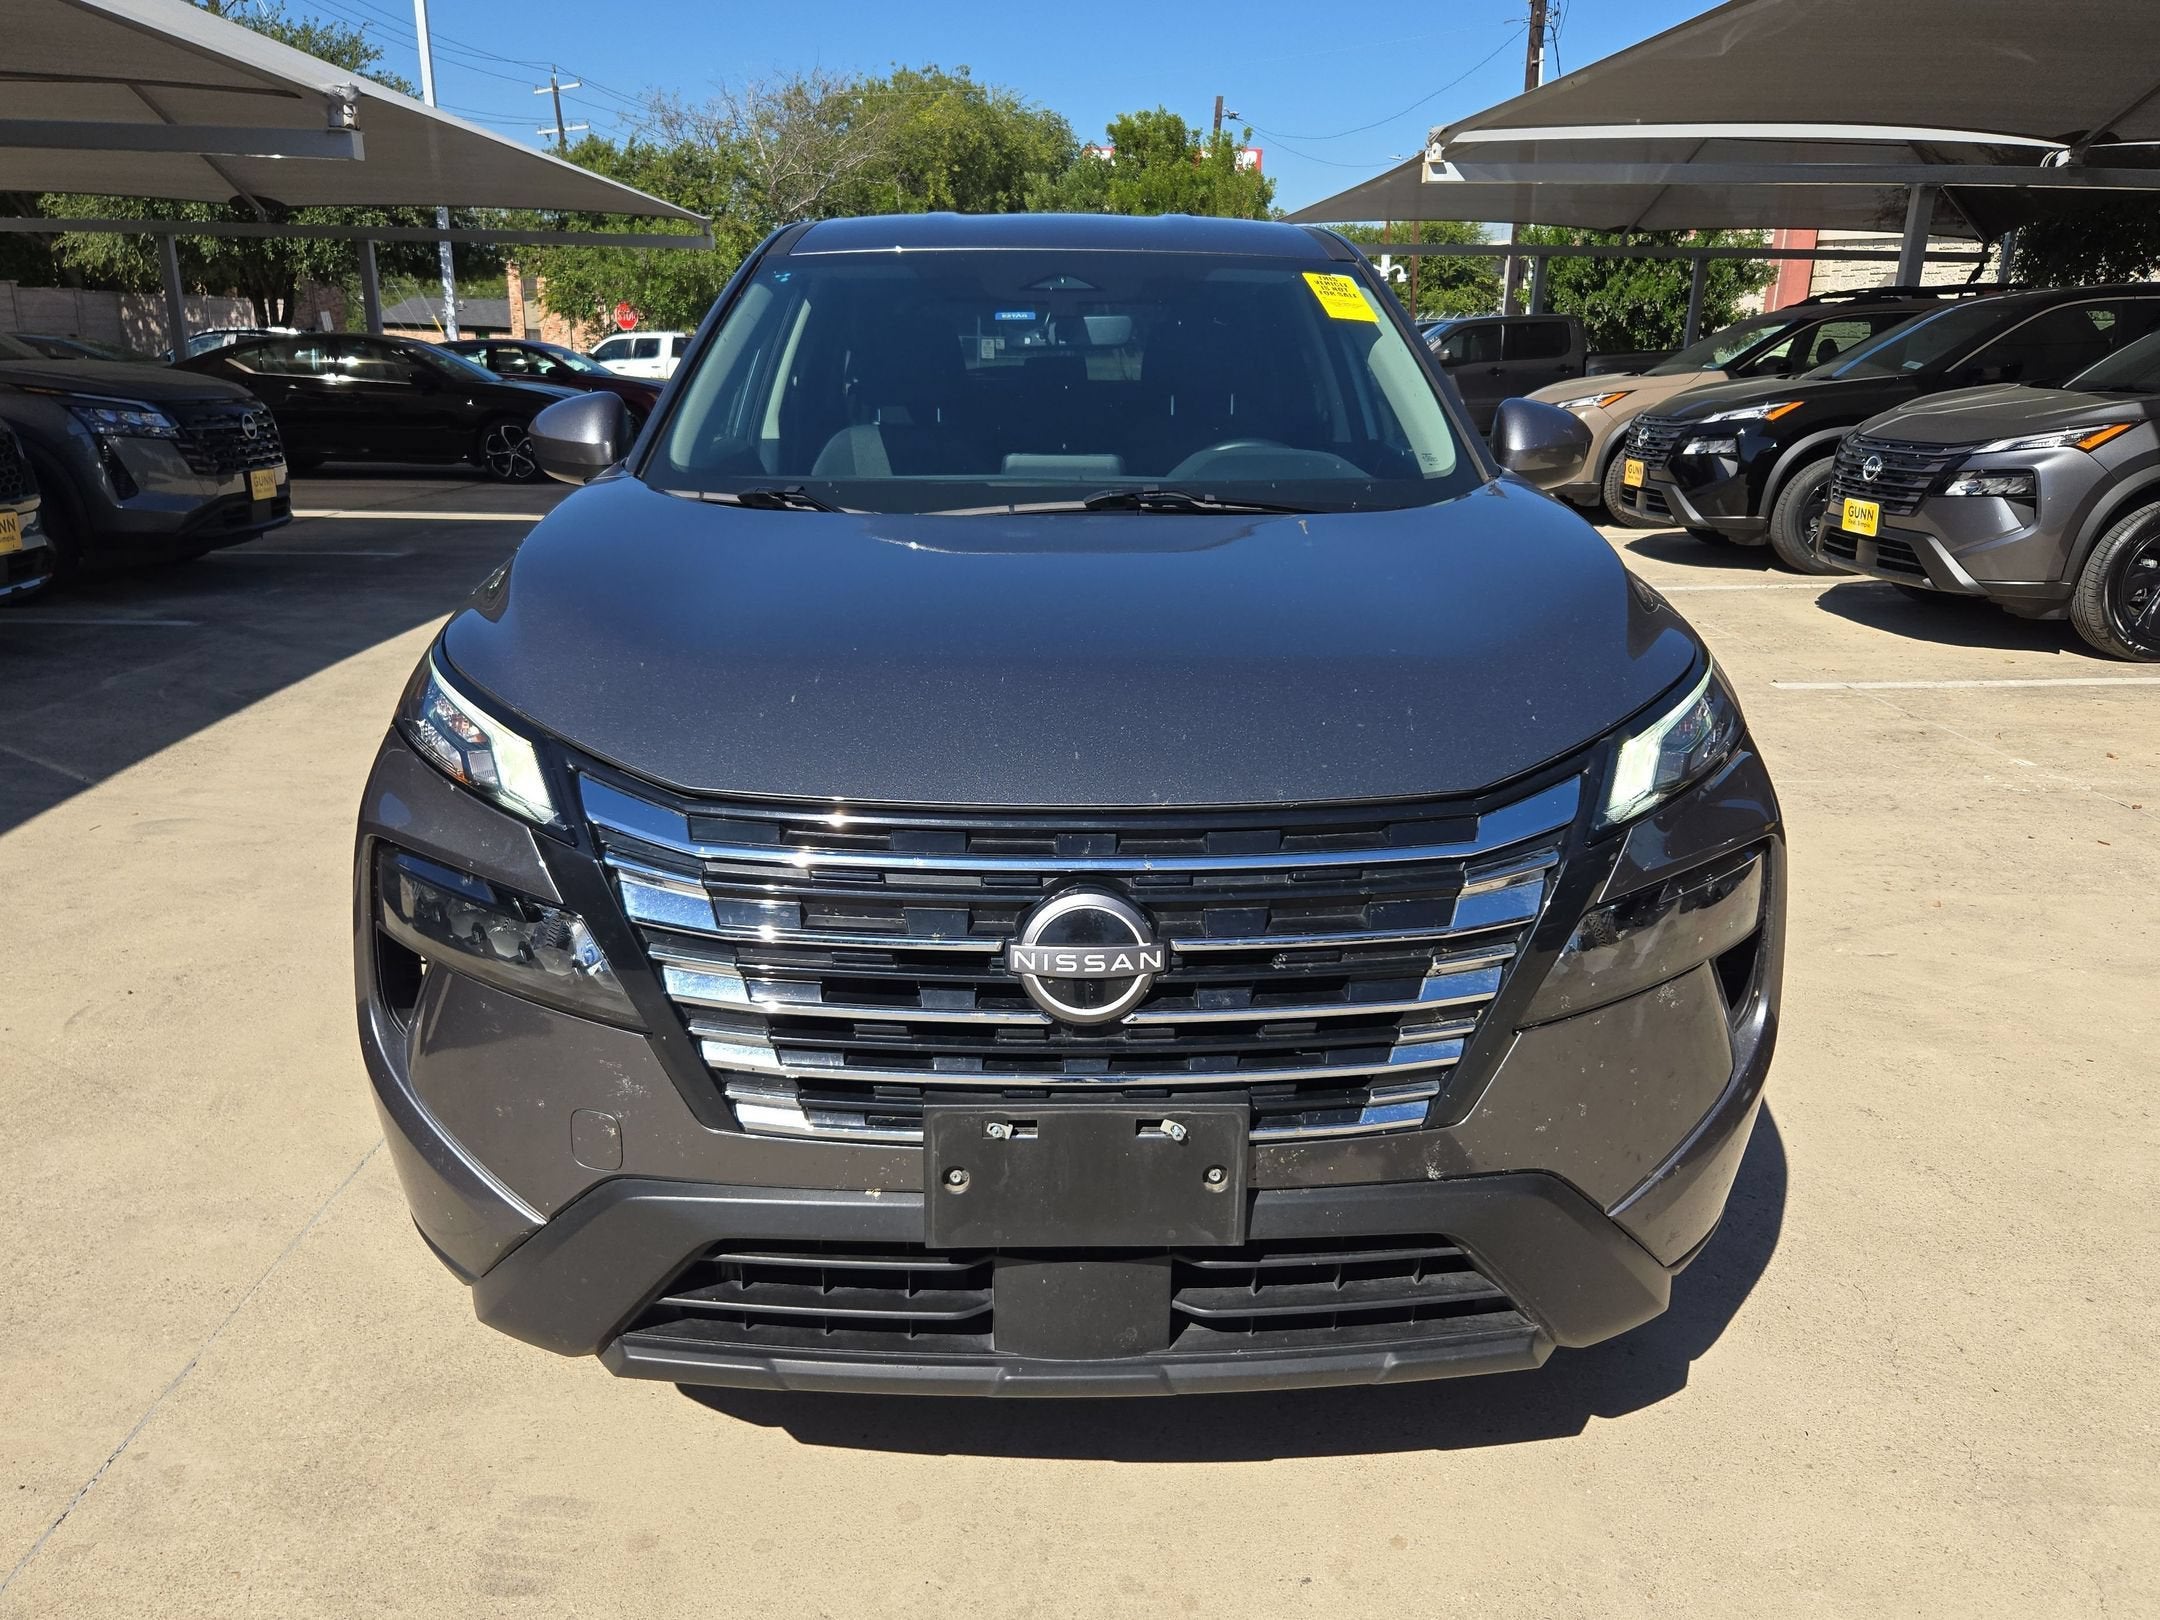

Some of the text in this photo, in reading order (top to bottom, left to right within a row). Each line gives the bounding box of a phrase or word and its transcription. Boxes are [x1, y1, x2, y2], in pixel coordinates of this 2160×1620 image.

[1848, 505, 1875, 521] GUNN
[0, 518, 16, 534] NN
[1014, 950, 1161, 972] NISSAN
